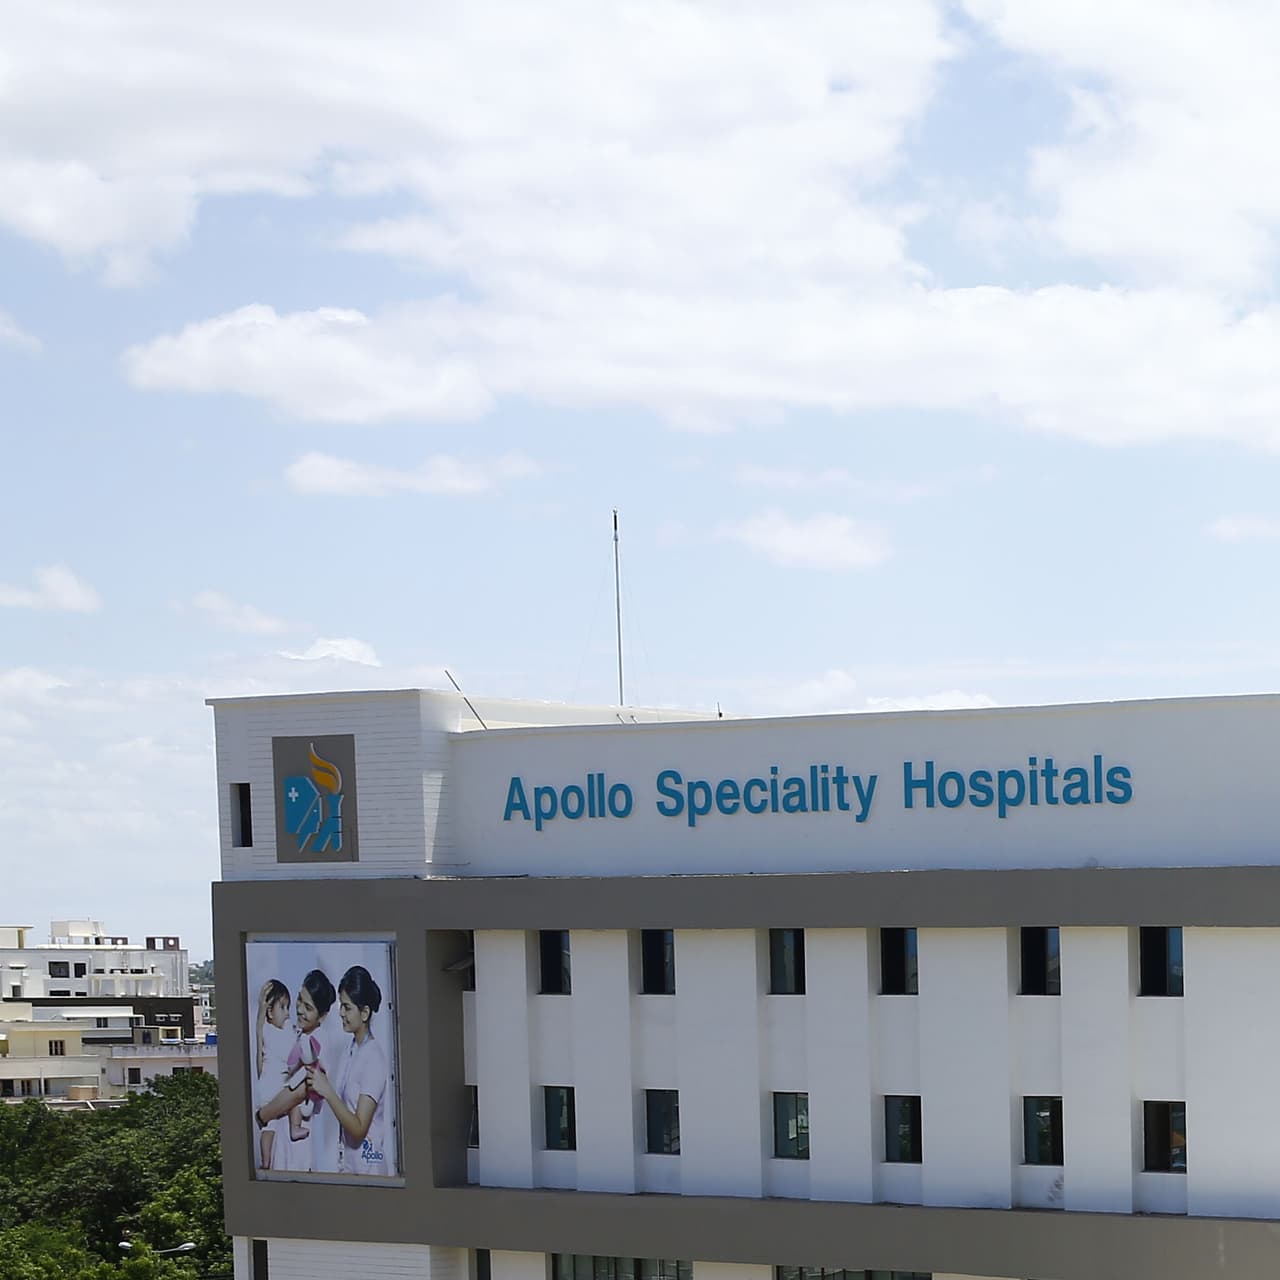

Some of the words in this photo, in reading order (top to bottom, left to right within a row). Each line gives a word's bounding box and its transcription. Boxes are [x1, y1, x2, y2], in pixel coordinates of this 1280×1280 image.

[503, 773, 633, 832] Apollo
[655, 764, 878, 827] Speciality
[903, 754, 1134, 819] Hospitals
[361, 1150, 384, 1164] Apollo
